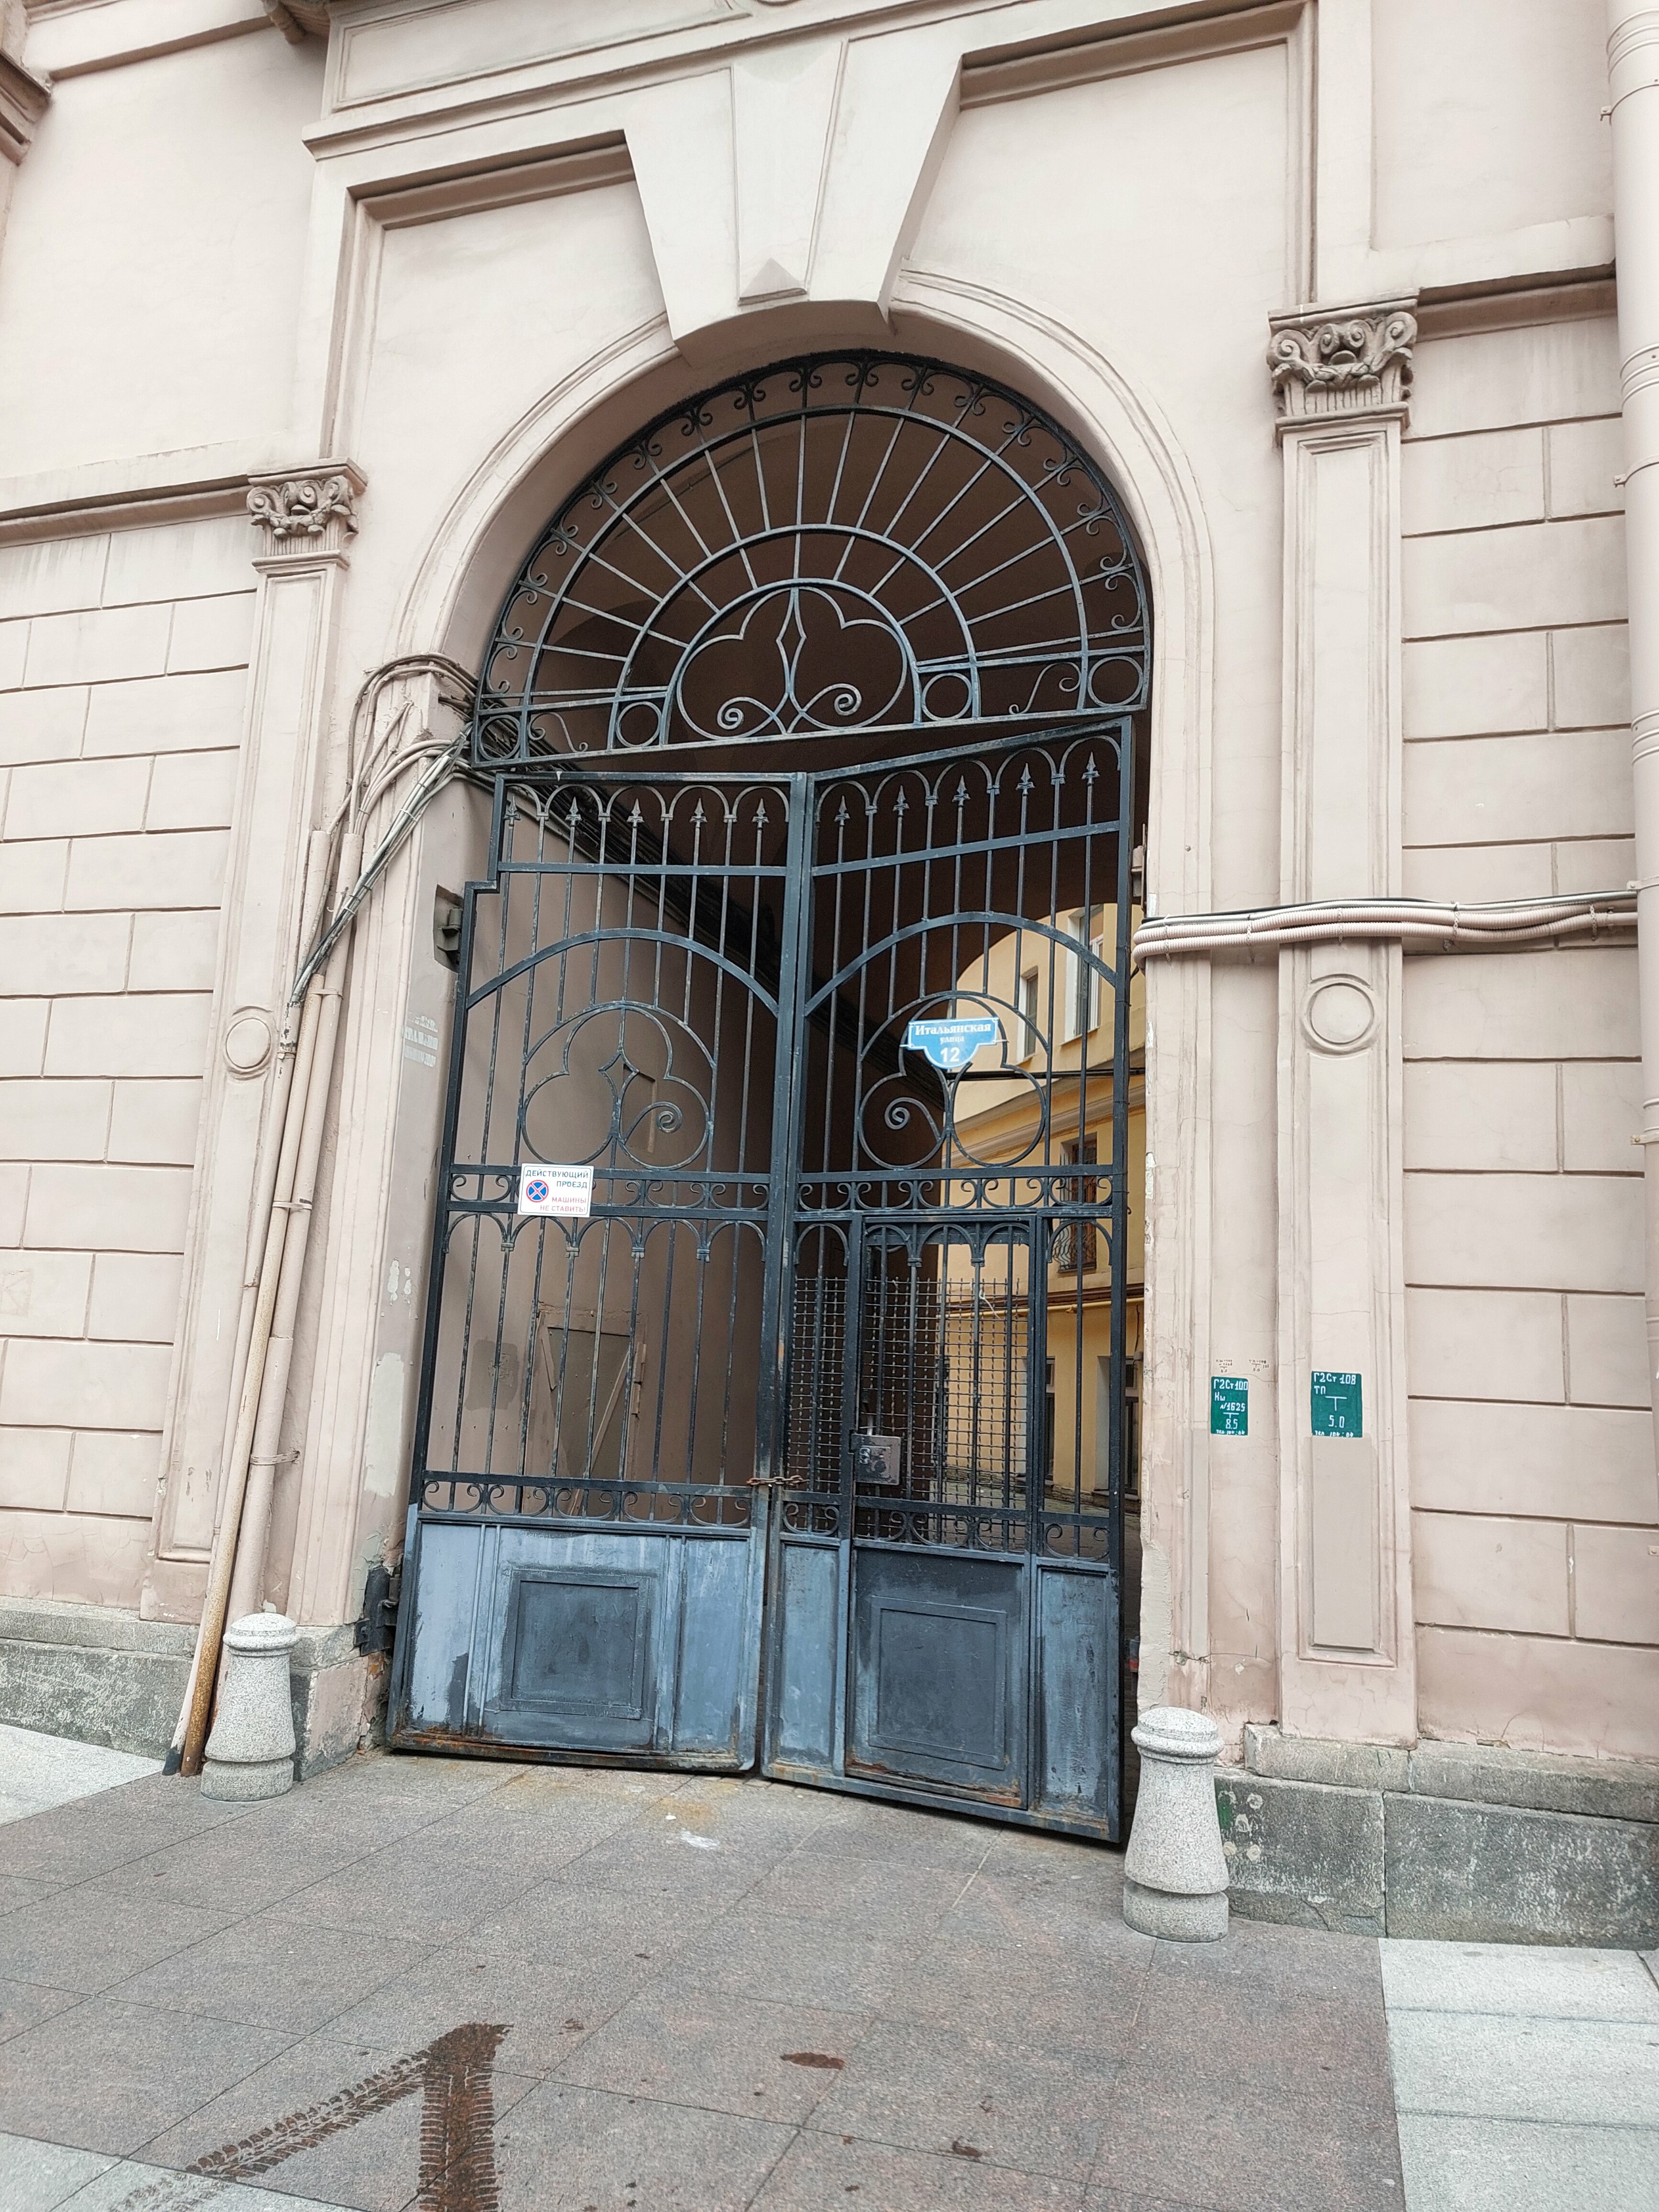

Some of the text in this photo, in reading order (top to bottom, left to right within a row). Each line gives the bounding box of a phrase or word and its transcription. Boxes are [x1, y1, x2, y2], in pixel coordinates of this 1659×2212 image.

[915, 1023, 991, 1036] Итальянская
[940, 1036, 964, 1044] улица
[940, 1047, 960, 1062] 12
[525, 1169, 588, 1179] ДЕЙСТВУЮЩИЙ
[556, 1181, 587, 1189] ПРОЕЗД
[1225, 1418, 1238, 1429] 8.5
[1328, 1415, 1345, 1428] 5.0
